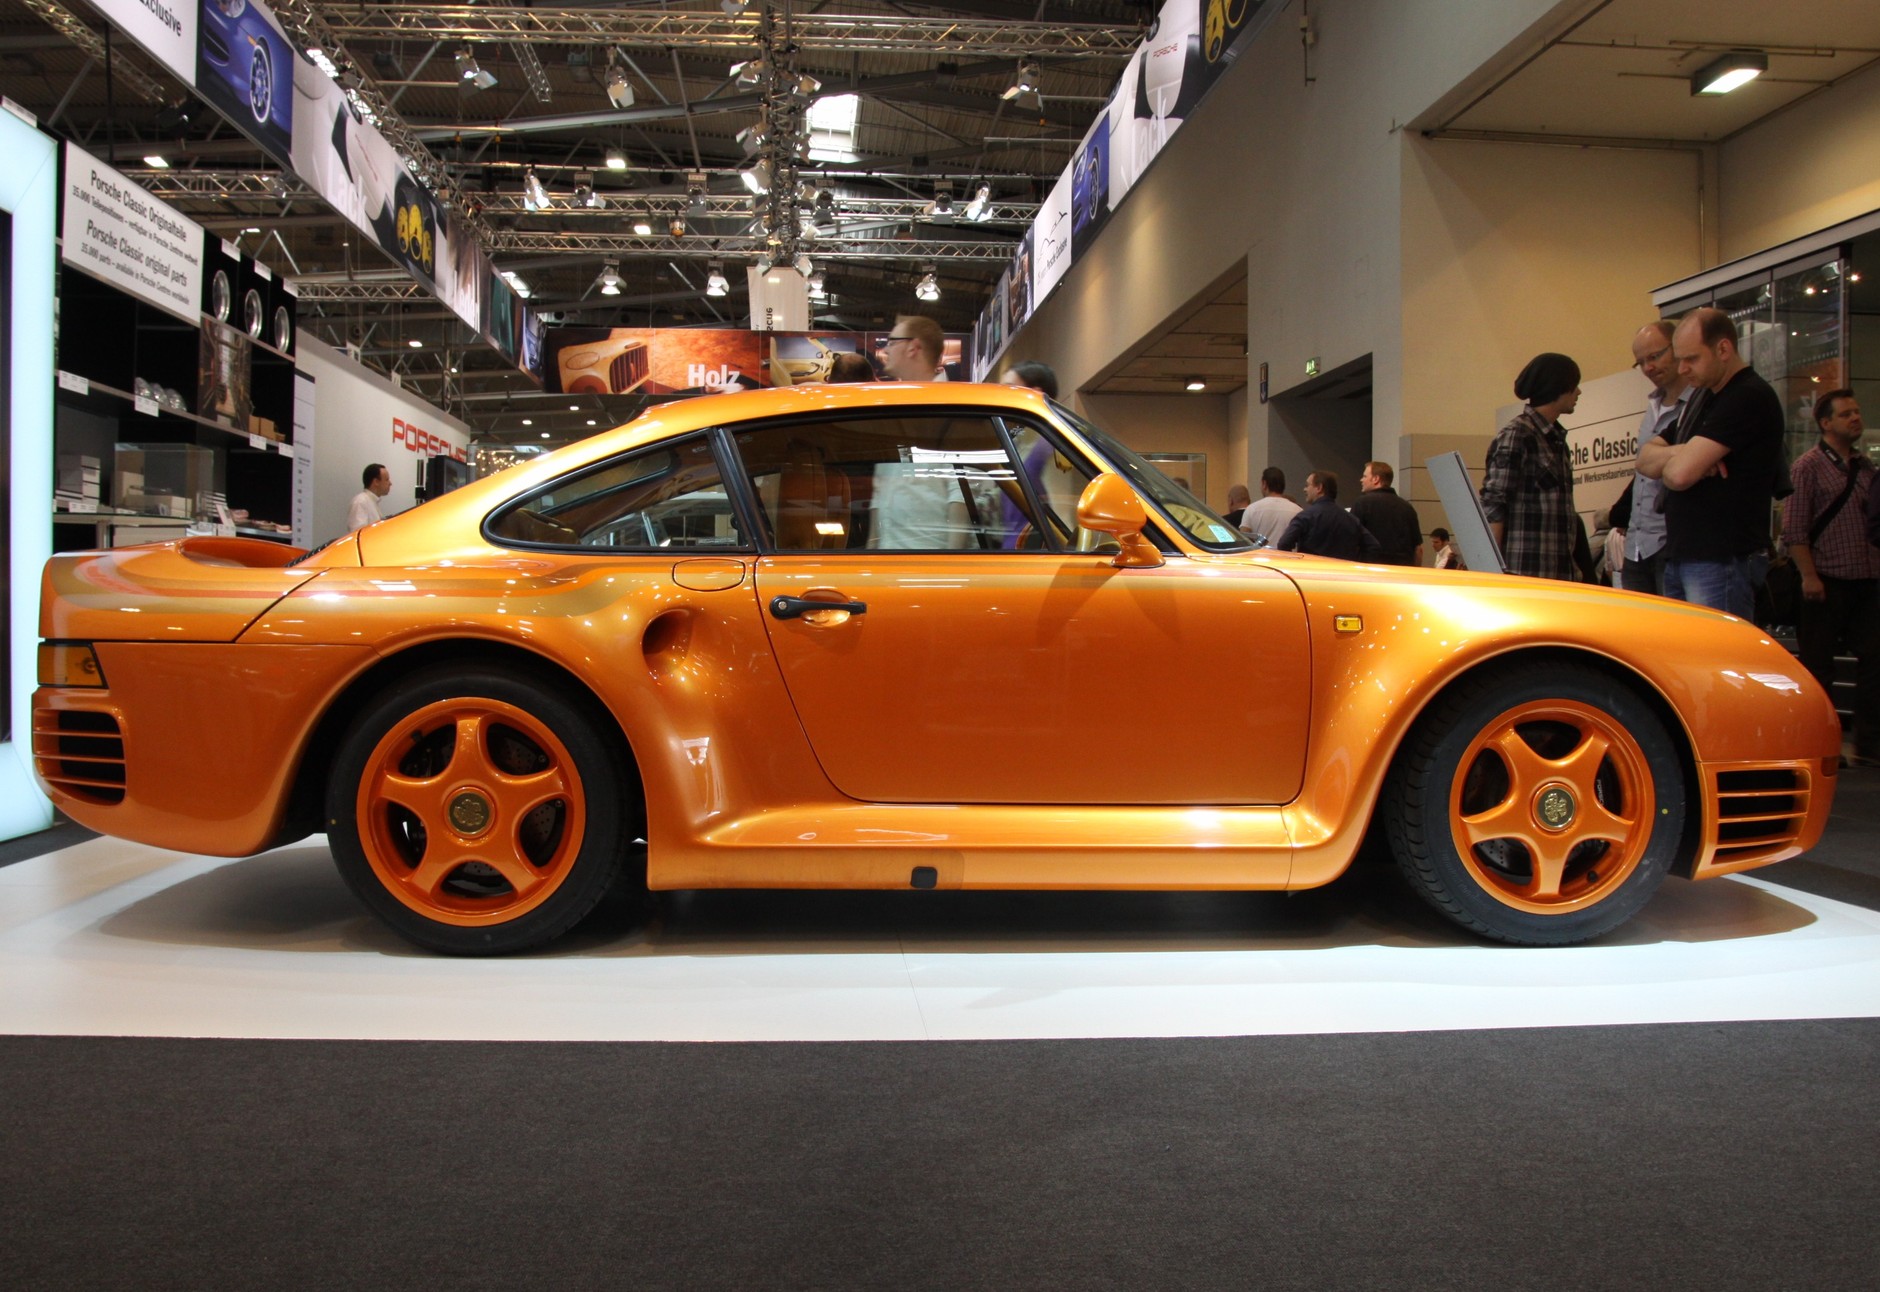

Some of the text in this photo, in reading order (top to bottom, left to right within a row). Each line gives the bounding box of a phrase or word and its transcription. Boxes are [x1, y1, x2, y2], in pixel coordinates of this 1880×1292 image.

[91, 170, 187, 242] Porsche Classic Originalteile
[87, 219, 187, 287] Porsche Classic original parts
[688, 364, 740, 387] Holz
[1593, 431, 1638, 462] Classic
[1584, 467, 1636, 483] Werksrestaurierun
